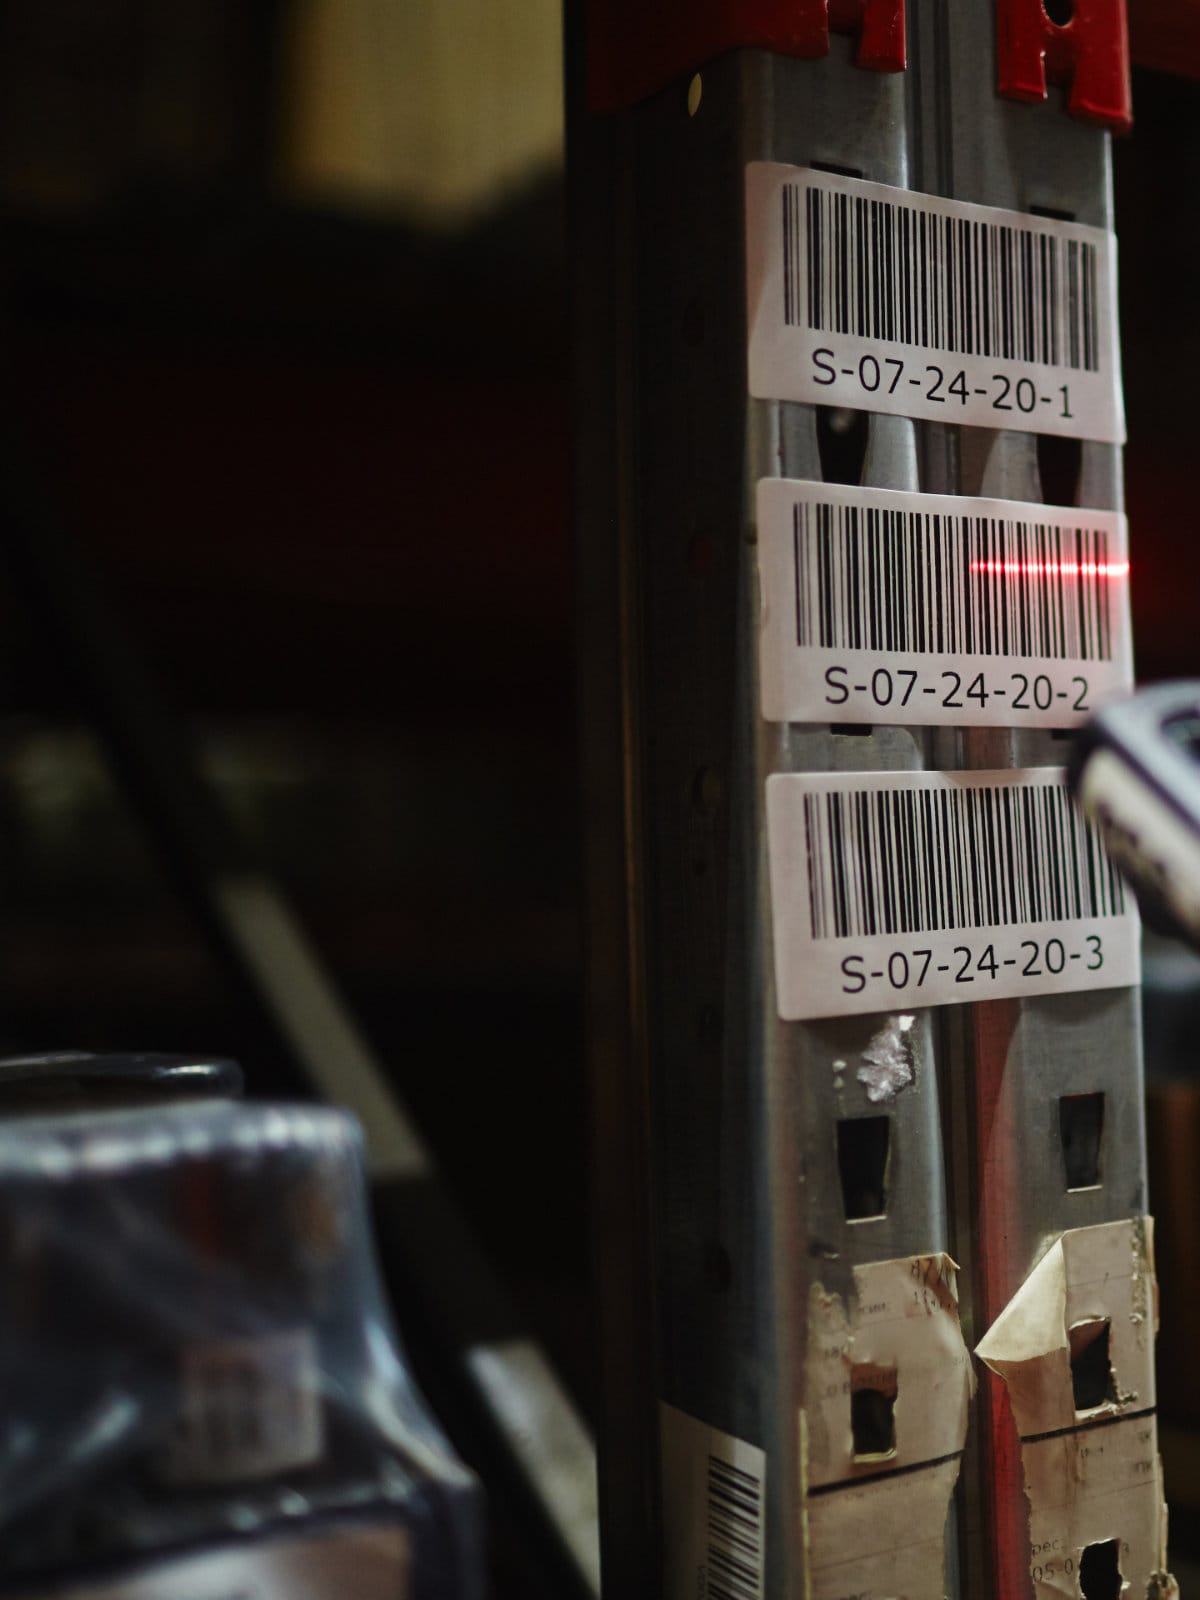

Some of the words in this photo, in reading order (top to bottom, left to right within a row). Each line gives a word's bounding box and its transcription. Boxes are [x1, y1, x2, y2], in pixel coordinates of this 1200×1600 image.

[812, 348, 1073, 418] S-07-24-20-1
[824, 666, 1089, 711] S-07-24-20-2
[841, 935, 1104, 994] S-07-24-20-3
